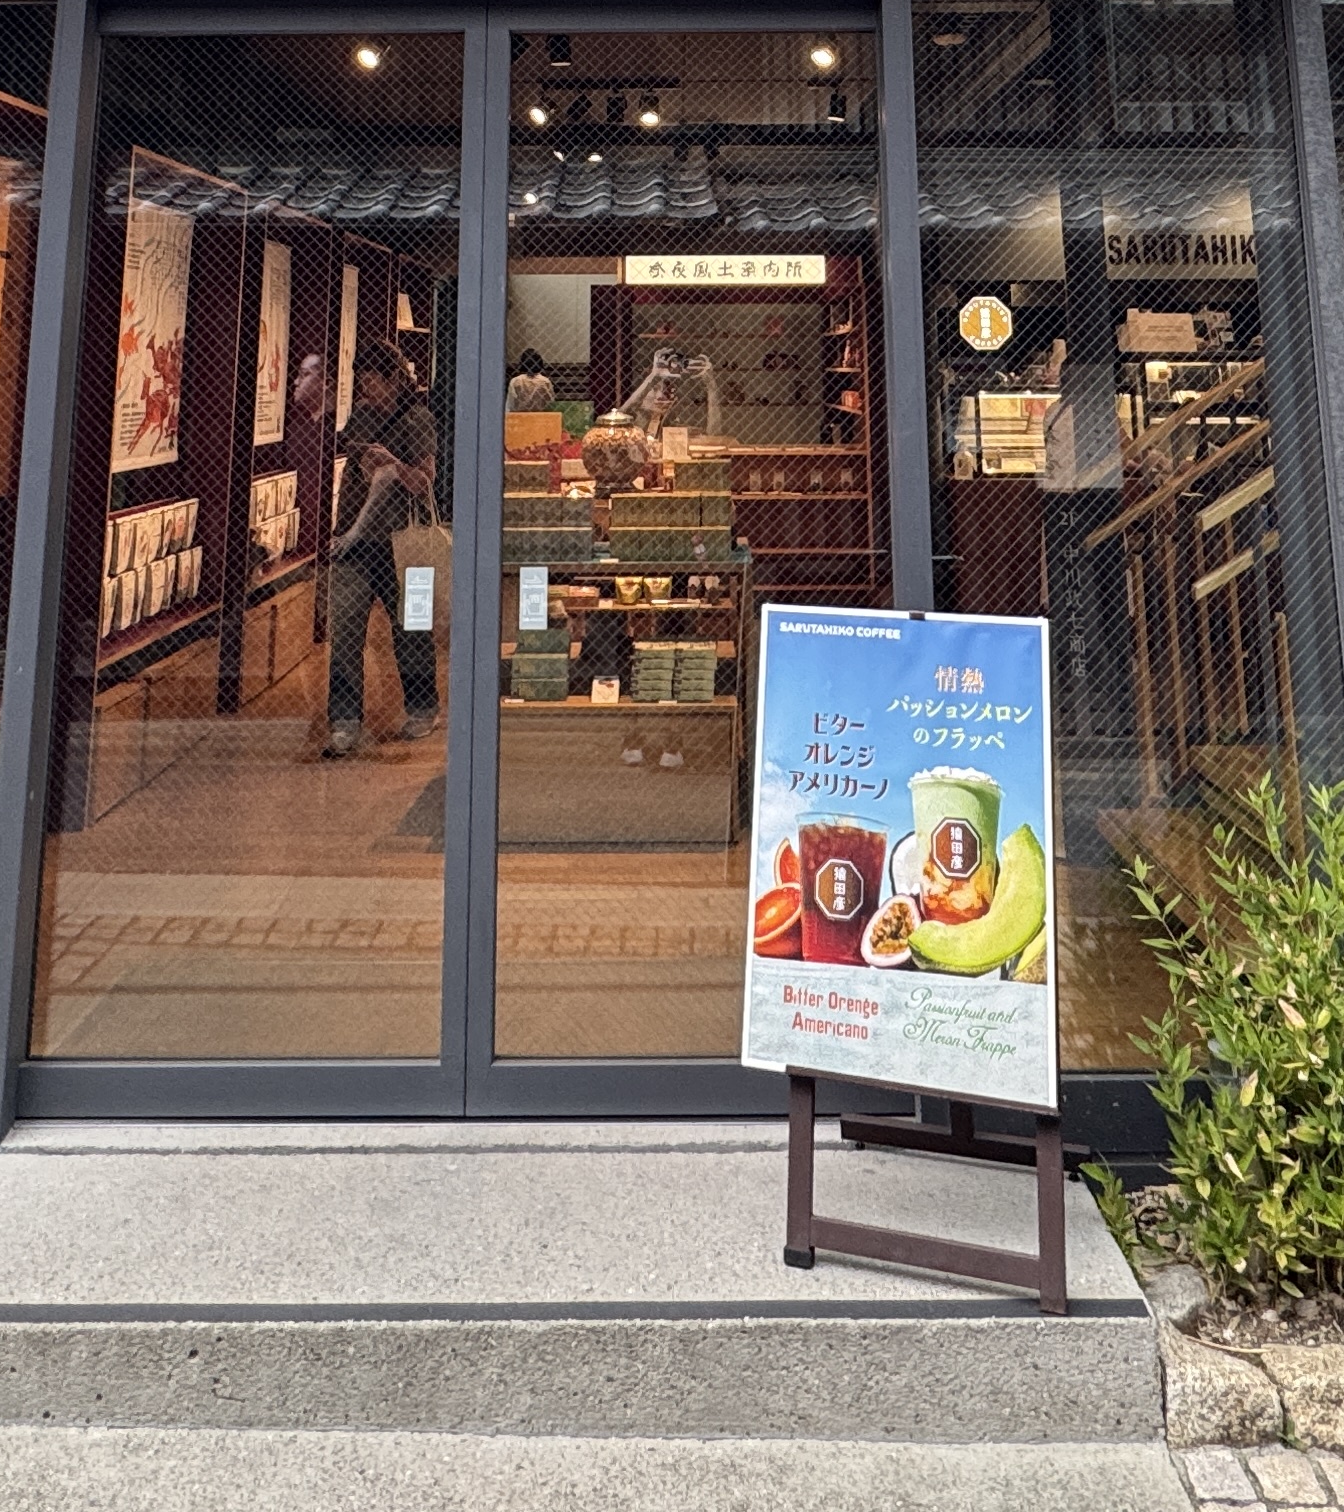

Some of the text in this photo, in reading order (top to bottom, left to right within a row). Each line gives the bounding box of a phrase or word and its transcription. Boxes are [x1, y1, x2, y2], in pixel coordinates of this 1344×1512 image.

[1108, 235, 1256, 265] SARUTAHIK
[779, 621, 901, 640] SARUTAHIKO COFFEE
[934, 665, 984, 694] 情熱
[886, 695, 1033, 724] パッションメロン
[813, 712, 865, 735] ビター
[913, 727, 1005, 751] のフラッペ
[804, 742, 875, 768] オレンジ
[788, 770, 889, 800] アメリカーノ
[783, 984, 824, 1008] Bitter
[792, 1011, 868, 1040] Americano
[987, 1007, 1017, 1024] and
